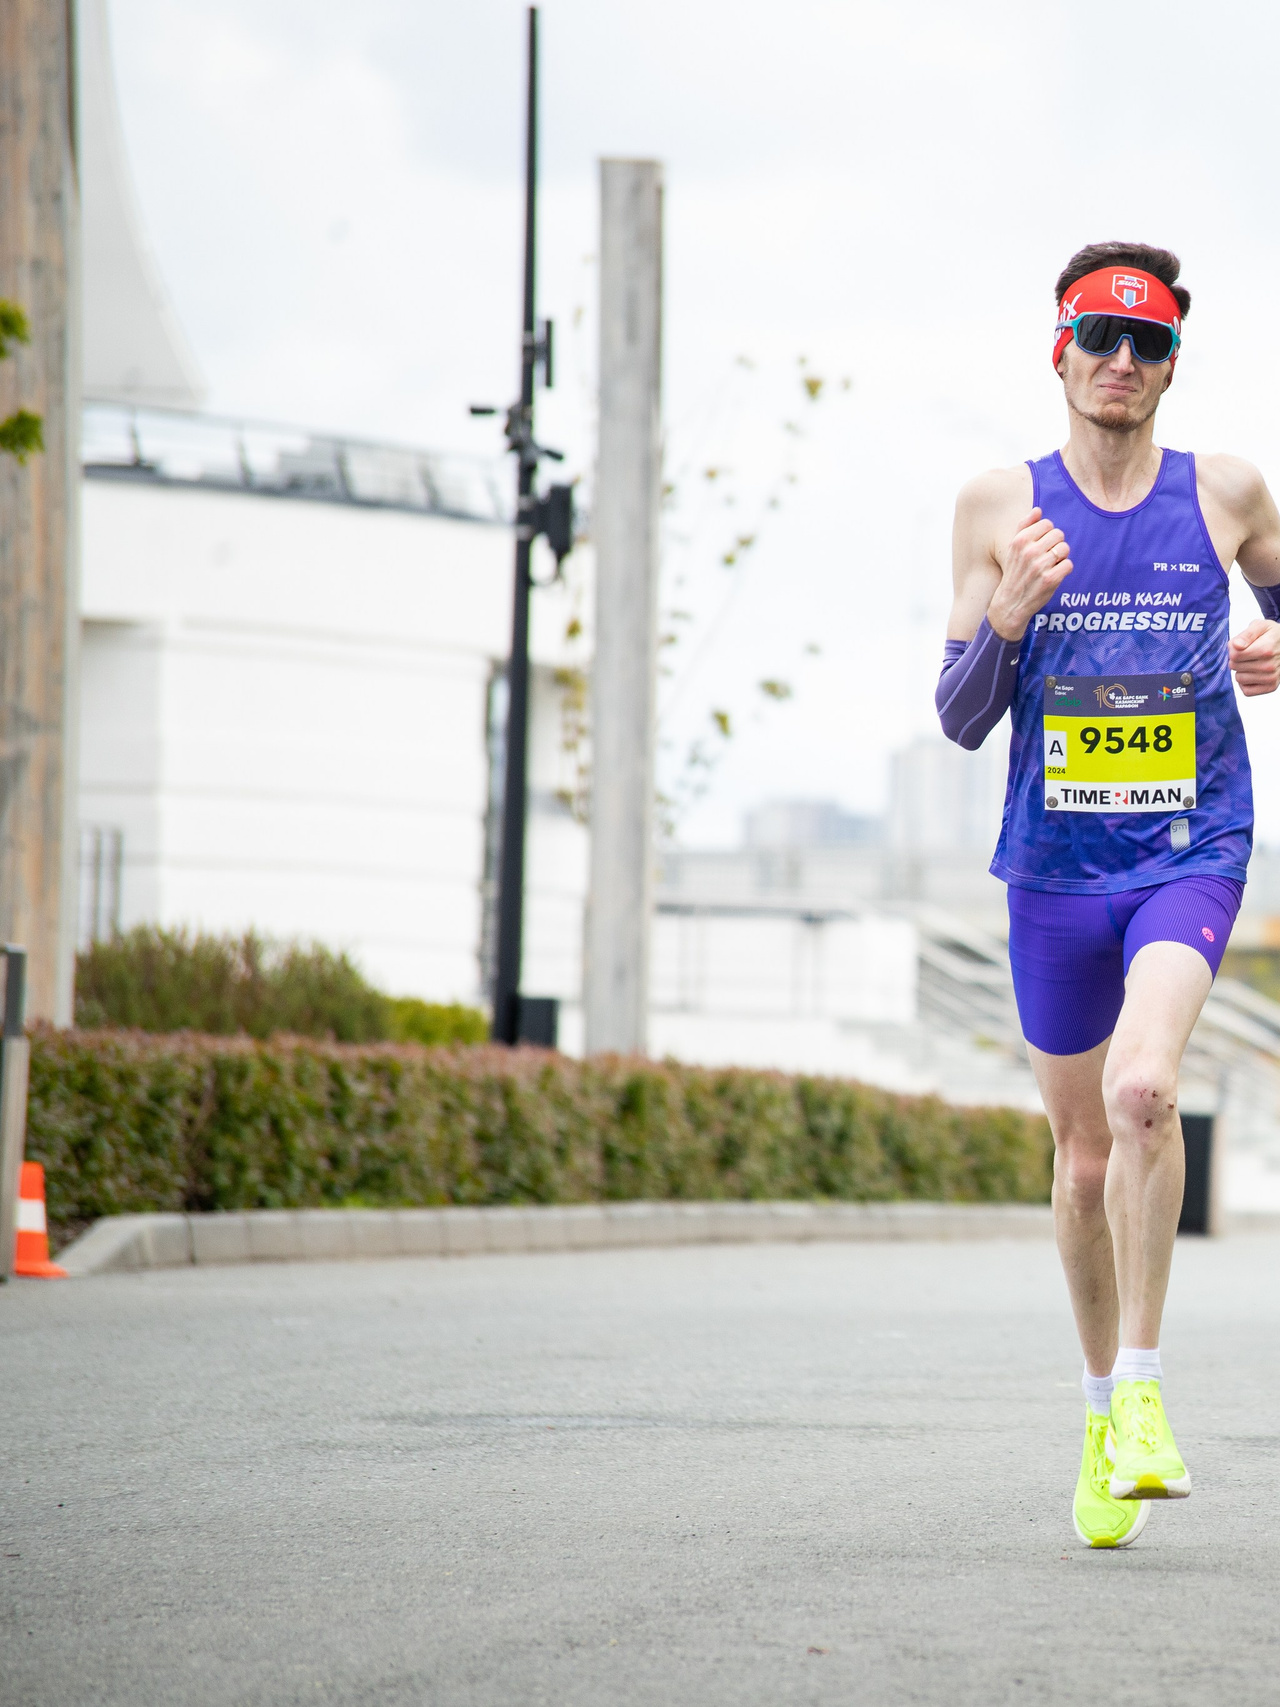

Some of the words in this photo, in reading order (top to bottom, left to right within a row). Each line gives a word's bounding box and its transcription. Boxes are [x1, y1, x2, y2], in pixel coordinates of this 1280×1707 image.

[1116, 279, 1144, 290] swix
[1153, 562, 1168, 572] PR
[1179, 563, 1200, 573] KZN
[1060, 592, 1092, 608] RUN
[1094, 592, 1131, 607] CLUB
[1135, 592, 1182, 607] KAZAN
[1034, 611, 1207, 632] PROGRESSIVE
[1080, 725, 1173, 754] 9548
[1049, 740, 1064, 756] A
[1047, 767, 1066, 775] 2024
